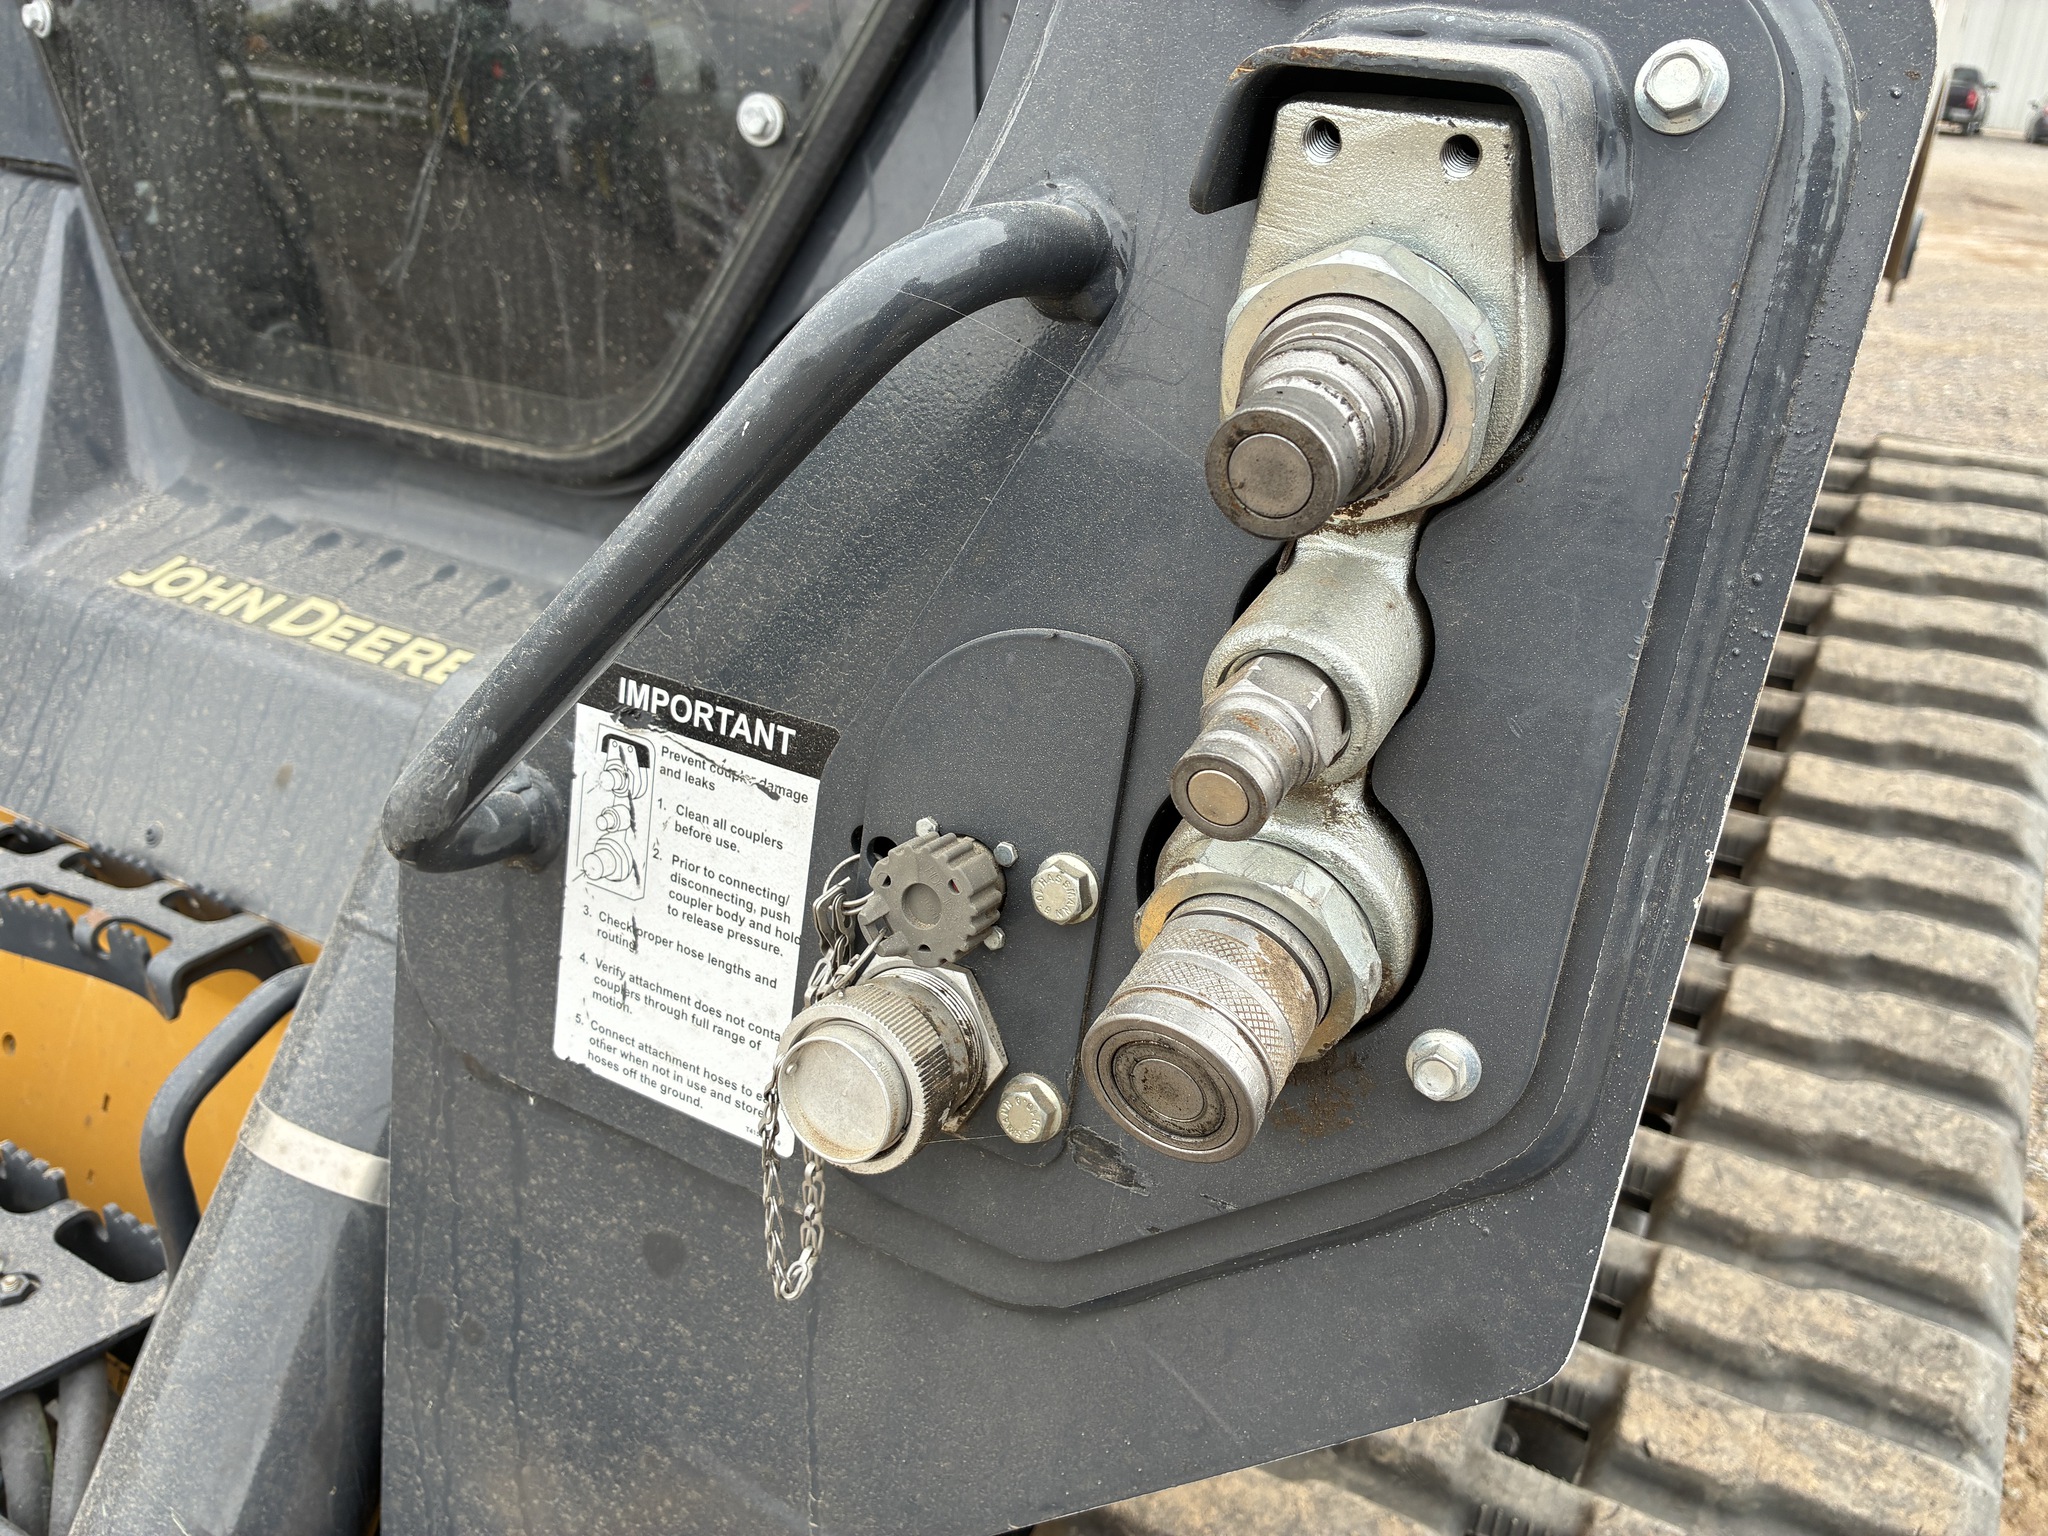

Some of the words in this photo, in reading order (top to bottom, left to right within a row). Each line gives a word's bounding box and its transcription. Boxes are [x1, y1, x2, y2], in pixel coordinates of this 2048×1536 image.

[117, 555, 288, 624] JOHN
[268, 596, 475, 685] DEERE
[618, 677, 796, 756] IMPORTANT
[660, 765, 680, 780] and
[685, 771, 715, 792] leaks
[661, 746, 706, 771] Prevent
[657, 798, 666, 811] 1.
[676, 805, 709, 825] Clean
[713, 816, 726, 831] all
[731, 822, 783, 850] couplers
[675, 822, 711, 843] before
[716, 837, 740, 853] use.
[653, 848, 662, 861] 2.
[672, 855, 700, 873] Prior
[704, 864, 715, 878] to
[718, 869, 789, 905] connecting/
[671, 872, 756, 913] disconnecting,
[760, 904, 790, 924] push
[668, 890, 712, 914] coupler
[716, 903, 745, 926] body
[749, 916, 771, 934] and
[775, 924, 801, 945] hold
[668, 904, 679, 917] to
[682, 909, 723, 934] release
[728, 925, 783, 956] pressure.
[583, 905, 592, 918] 3.
[599, 911, 633, 932] Check
[637, 926, 673, 949] proper
[677, 940, 704, 961] hose
[708, 953, 751, 979] lengths
[755, 971, 777, 989] and
[579, 953, 588, 965] 4.
[596, 958, 626, 981] Verify
[629, 970, 691, 1006] attachment
[695, 998, 722, 1019] does
[726, 1010, 744, 1028] not
[748, 1021, 780, 1042] conta
[592, 990, 633, 1014] motion.
[594, 976, 641, 1001] couplers
[644, 990, 687, 1020] through
[691, 1013, 709, 1030] full
[712, 1020, 745, 1044] range
[749, 1036, 762, 1051] of
[576, 1014, 584, 1026] 5.
[591, 1021, 634, 1046] Connect
[638, 1036, 699, 1074] attachment
[703, 1065, 737, 1091] hoses
[742, 1080, 752, 1095] to
[588, 1050, 619, 1071] hoses
[623, 1063, 638, 1080] off
[641, 1071, 657, 1087] the
[660, 1080, 703, 1109] ground.
[589, 1036, 617, 1059] other
[620, 1046, 649, 1067] when
[652, 1058, 670, 1077] not
[673, 1066, 683, 1081] in
[687, 1075, 707, 1092] use
[710, 1085, 731, 1104] and
[735, 1096, 763, 1118] store
